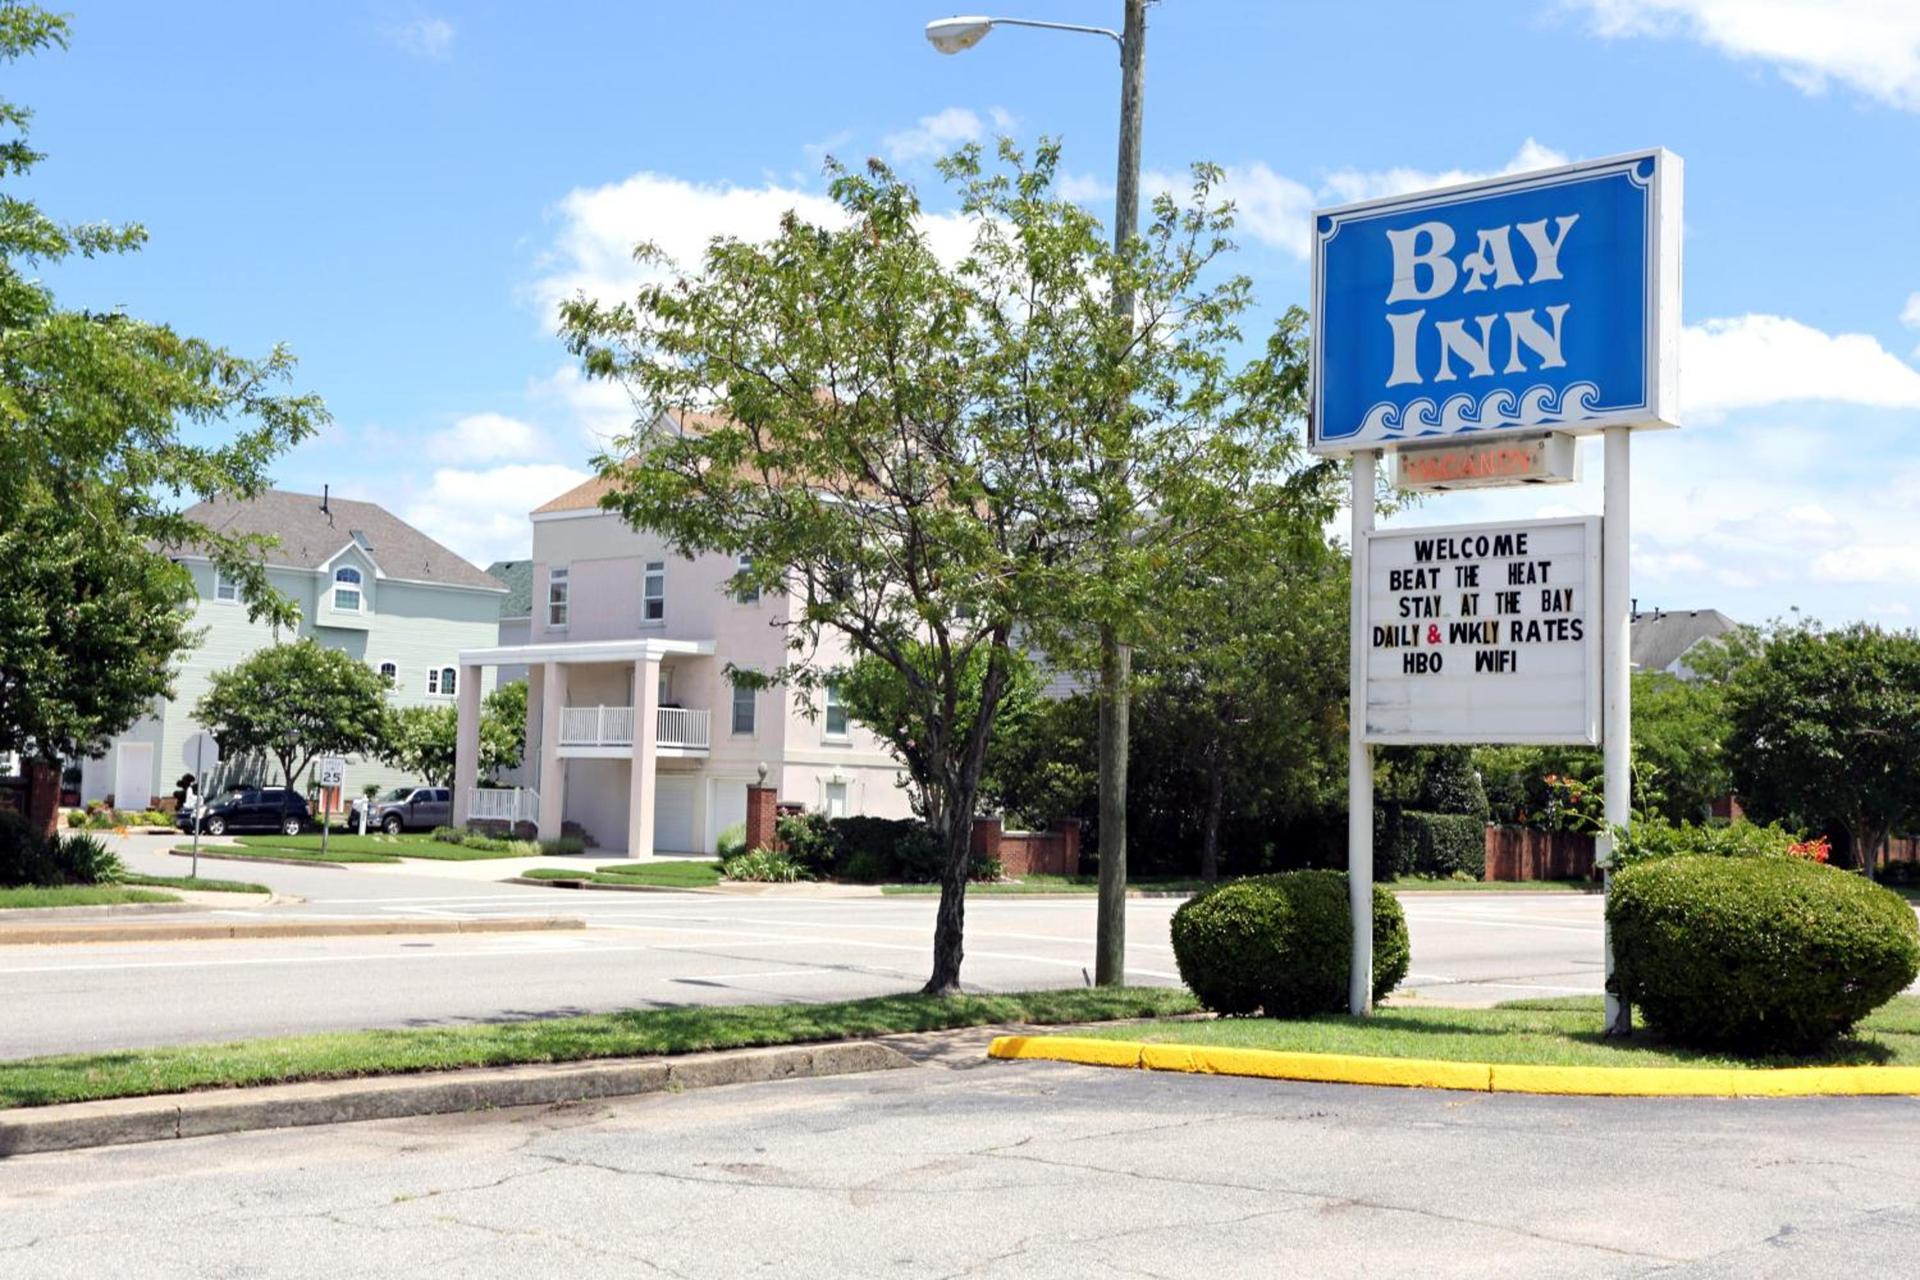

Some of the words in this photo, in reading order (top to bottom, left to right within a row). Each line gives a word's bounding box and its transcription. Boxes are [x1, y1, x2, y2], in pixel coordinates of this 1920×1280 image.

[1385, 213, 1580, 305] BAY
[1385, 303, 1571, 388] INN
[1414, 533, 1528, 561] WELCOME
[1389, 567, 1441, 591] BEAT
[1454, 564, 1480, 588] THE
[1508, 561, 1552, 585] HEAT
[1399, 595, 1442, 618] STAY
[1460, 593, 1480, 616] AT
[1495, 591, 1521, 614] THE
[1541, 588, 1574, 612] BAY
[1373, 623, 1420, 648] DAILY
[1426, 623, 1442, 645] &
[1449, 620, 1500, 645] WKLY
[1510, 618, 1584, 642] RATES
[1402, 651, 1443, 674] HBO
[1475, 649, 1517, 673] WIFI
[323, 771, 341, 782] 25
